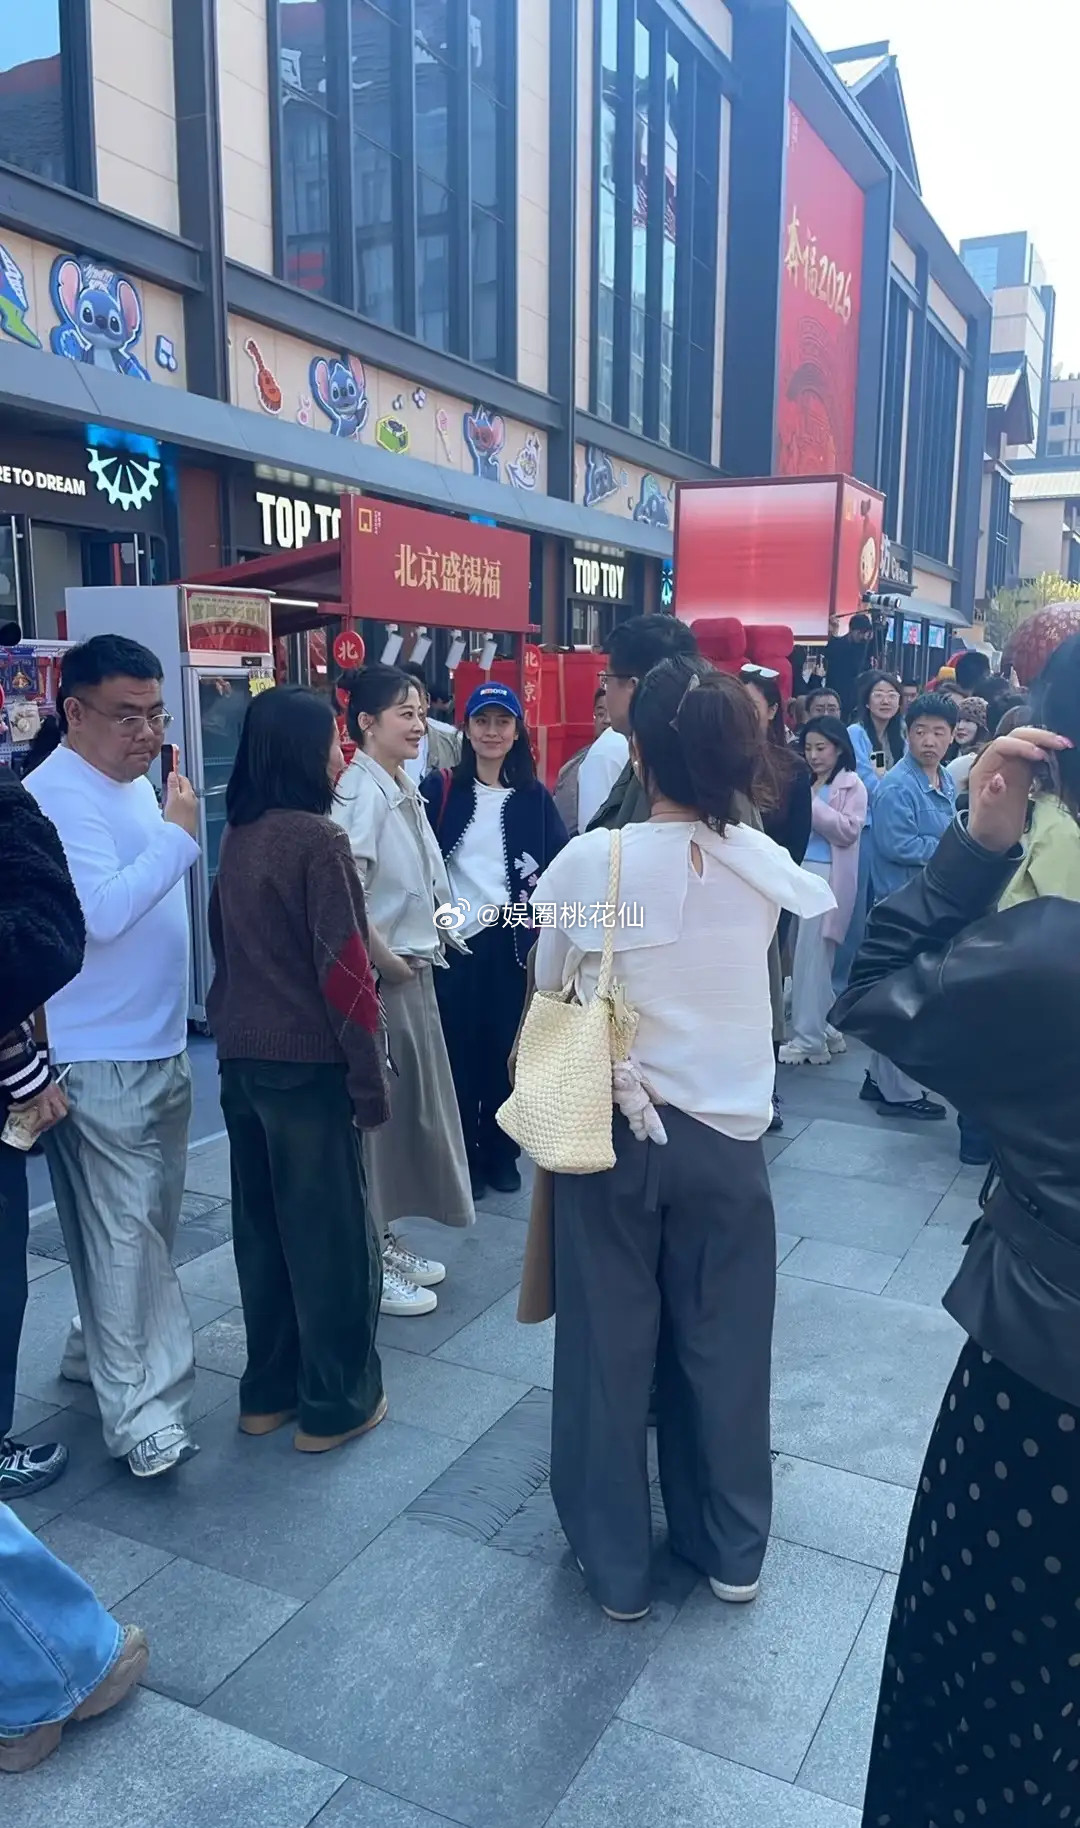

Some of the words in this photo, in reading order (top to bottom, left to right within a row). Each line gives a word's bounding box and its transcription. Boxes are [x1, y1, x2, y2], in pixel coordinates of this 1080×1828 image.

[12, 467, 34, 487] TO
[36, 471, 86, 496] DREAM
[256, 491, 311, 549] TOP
[394, 543, 501, 600] 北京盛锡福
[573, 557, 600, 595] TOP
[600, 562, 625, 599] TOY
[338, 640, 359, 661] 北
